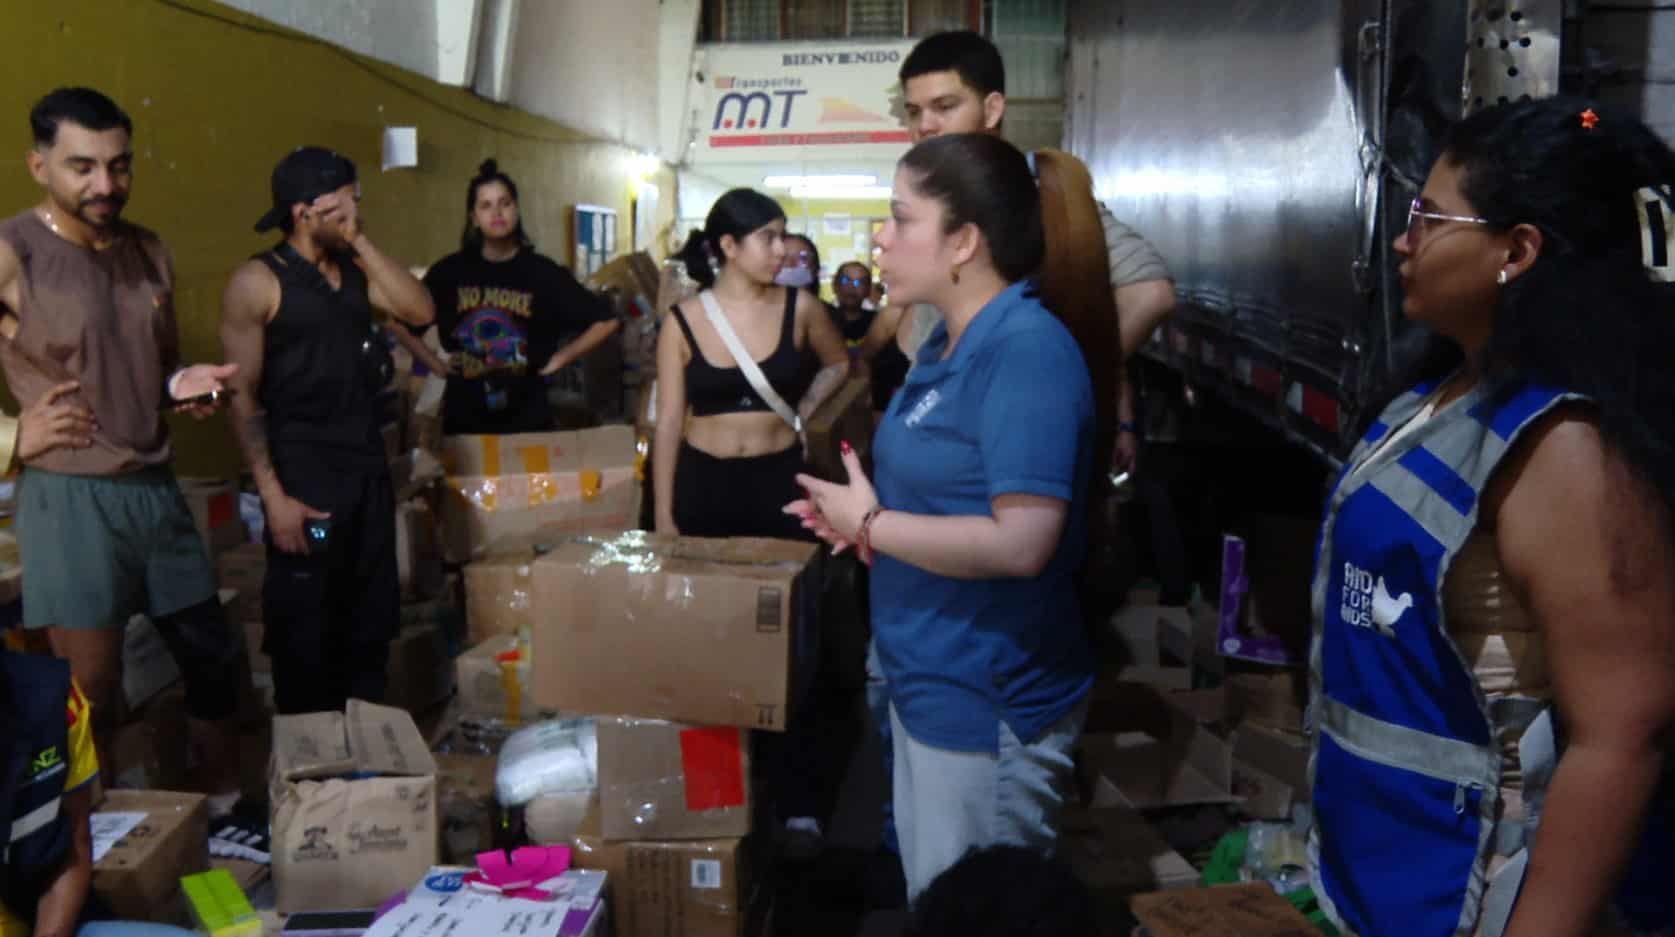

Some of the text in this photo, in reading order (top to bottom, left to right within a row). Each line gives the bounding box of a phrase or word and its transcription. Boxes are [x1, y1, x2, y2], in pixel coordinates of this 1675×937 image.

[782, 51, 900, 66] BIENVENIDO
[457, 285, 534, 319] NO MORE
[1344, 561, 1373, 594] AID
[1342, 584, 1371, 613] FOR
